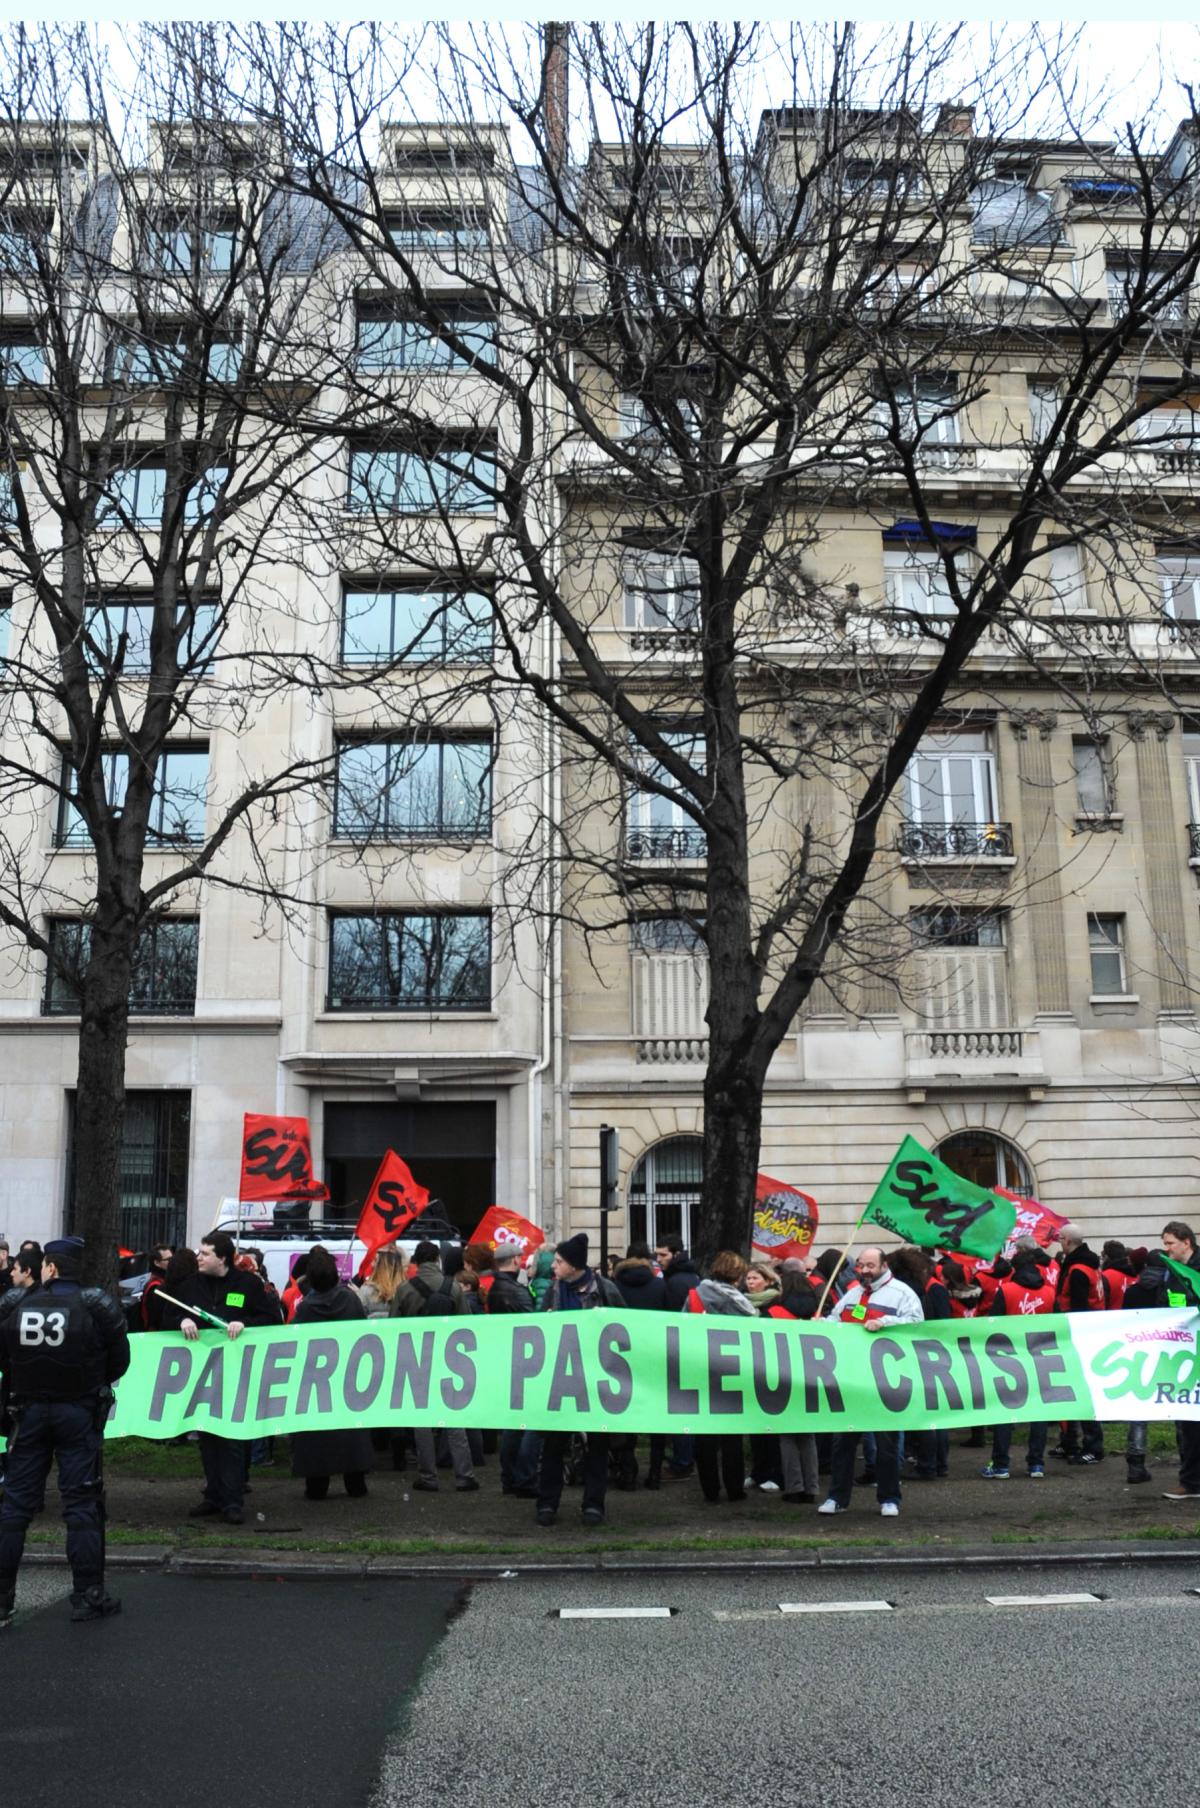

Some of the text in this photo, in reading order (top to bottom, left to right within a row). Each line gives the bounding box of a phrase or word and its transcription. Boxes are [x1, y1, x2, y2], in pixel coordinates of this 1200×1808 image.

[890, 1161, 995, 1248] Sud
[754, 1210, 811, 1245] dustrie
[1018, 1292, 1045, 1315] Virgin
[20, 1311, 65, 1347] B3
[1124, 1327, 1195, 1343] Solidaires
[148, 1328, 477, 1423] PAIERONS
[510, 1322, 633, 1415] PAS
[666, 1326, 846, 1414] LEUR
[870, 1331, 1077, 1413] CRISE
